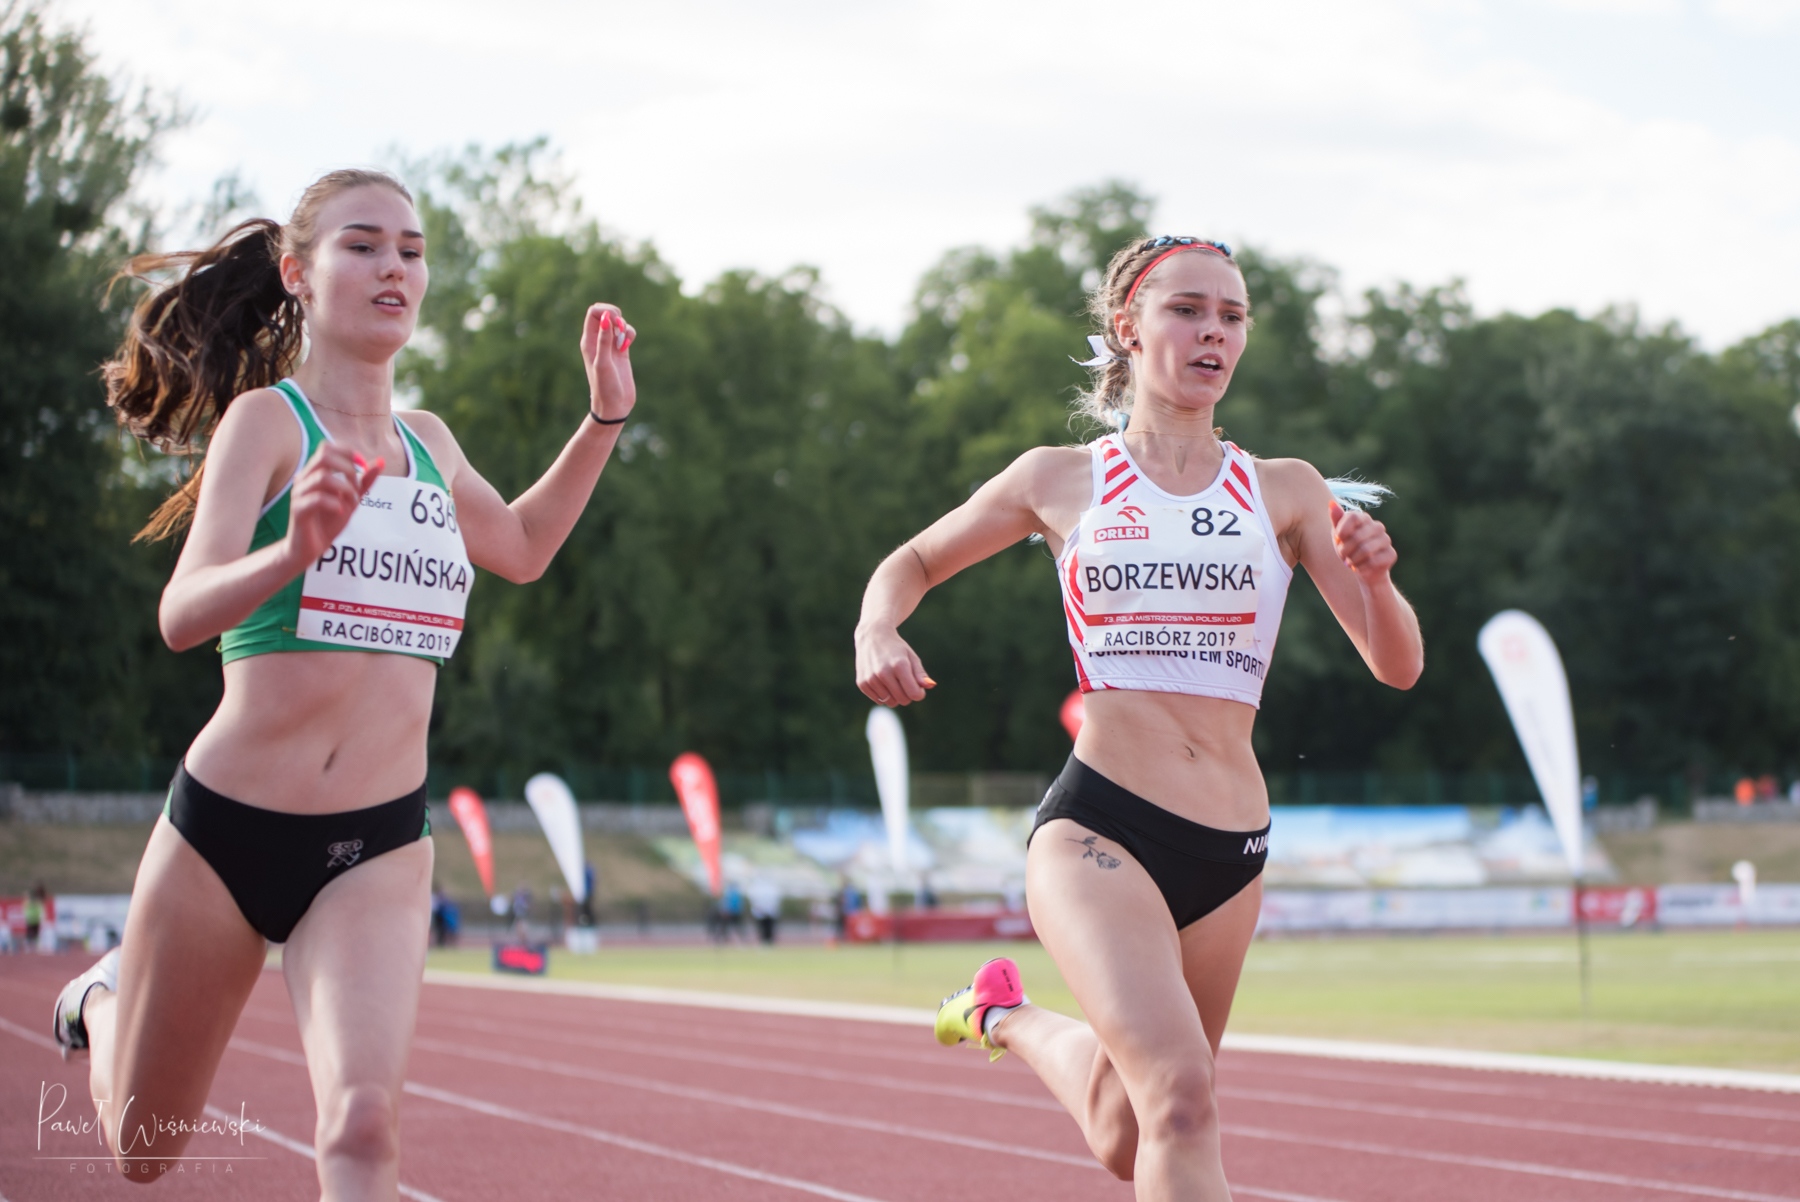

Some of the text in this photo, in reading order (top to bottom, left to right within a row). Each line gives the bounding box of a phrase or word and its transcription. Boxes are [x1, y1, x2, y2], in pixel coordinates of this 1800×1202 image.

[360, 496, 393, 510] cibórz
[411, 489, 458, 534] 636
[1096, 527, 1146, 541] ORLEN
[1191, 507, 1241, 536] 82
[315, 544, 467, 593] PRUSIŃSKA
[1085, 562, 1256, 593] BORZEWSKA
[338, 604, 362, 614] PZLA
[364, 608, 417, 621] MISTRZOSTWA
[1116, 615, 1135, 623] PZLA
[1135, 614, 1194, 622] MISTRZOSTWA
[1195, 615, 1225, 623] POLSKI
[321, 619, 452, 652] RACIBÓRZ 2019
[1104, 626, 1236, 647] RACIBÓRZ 2019
